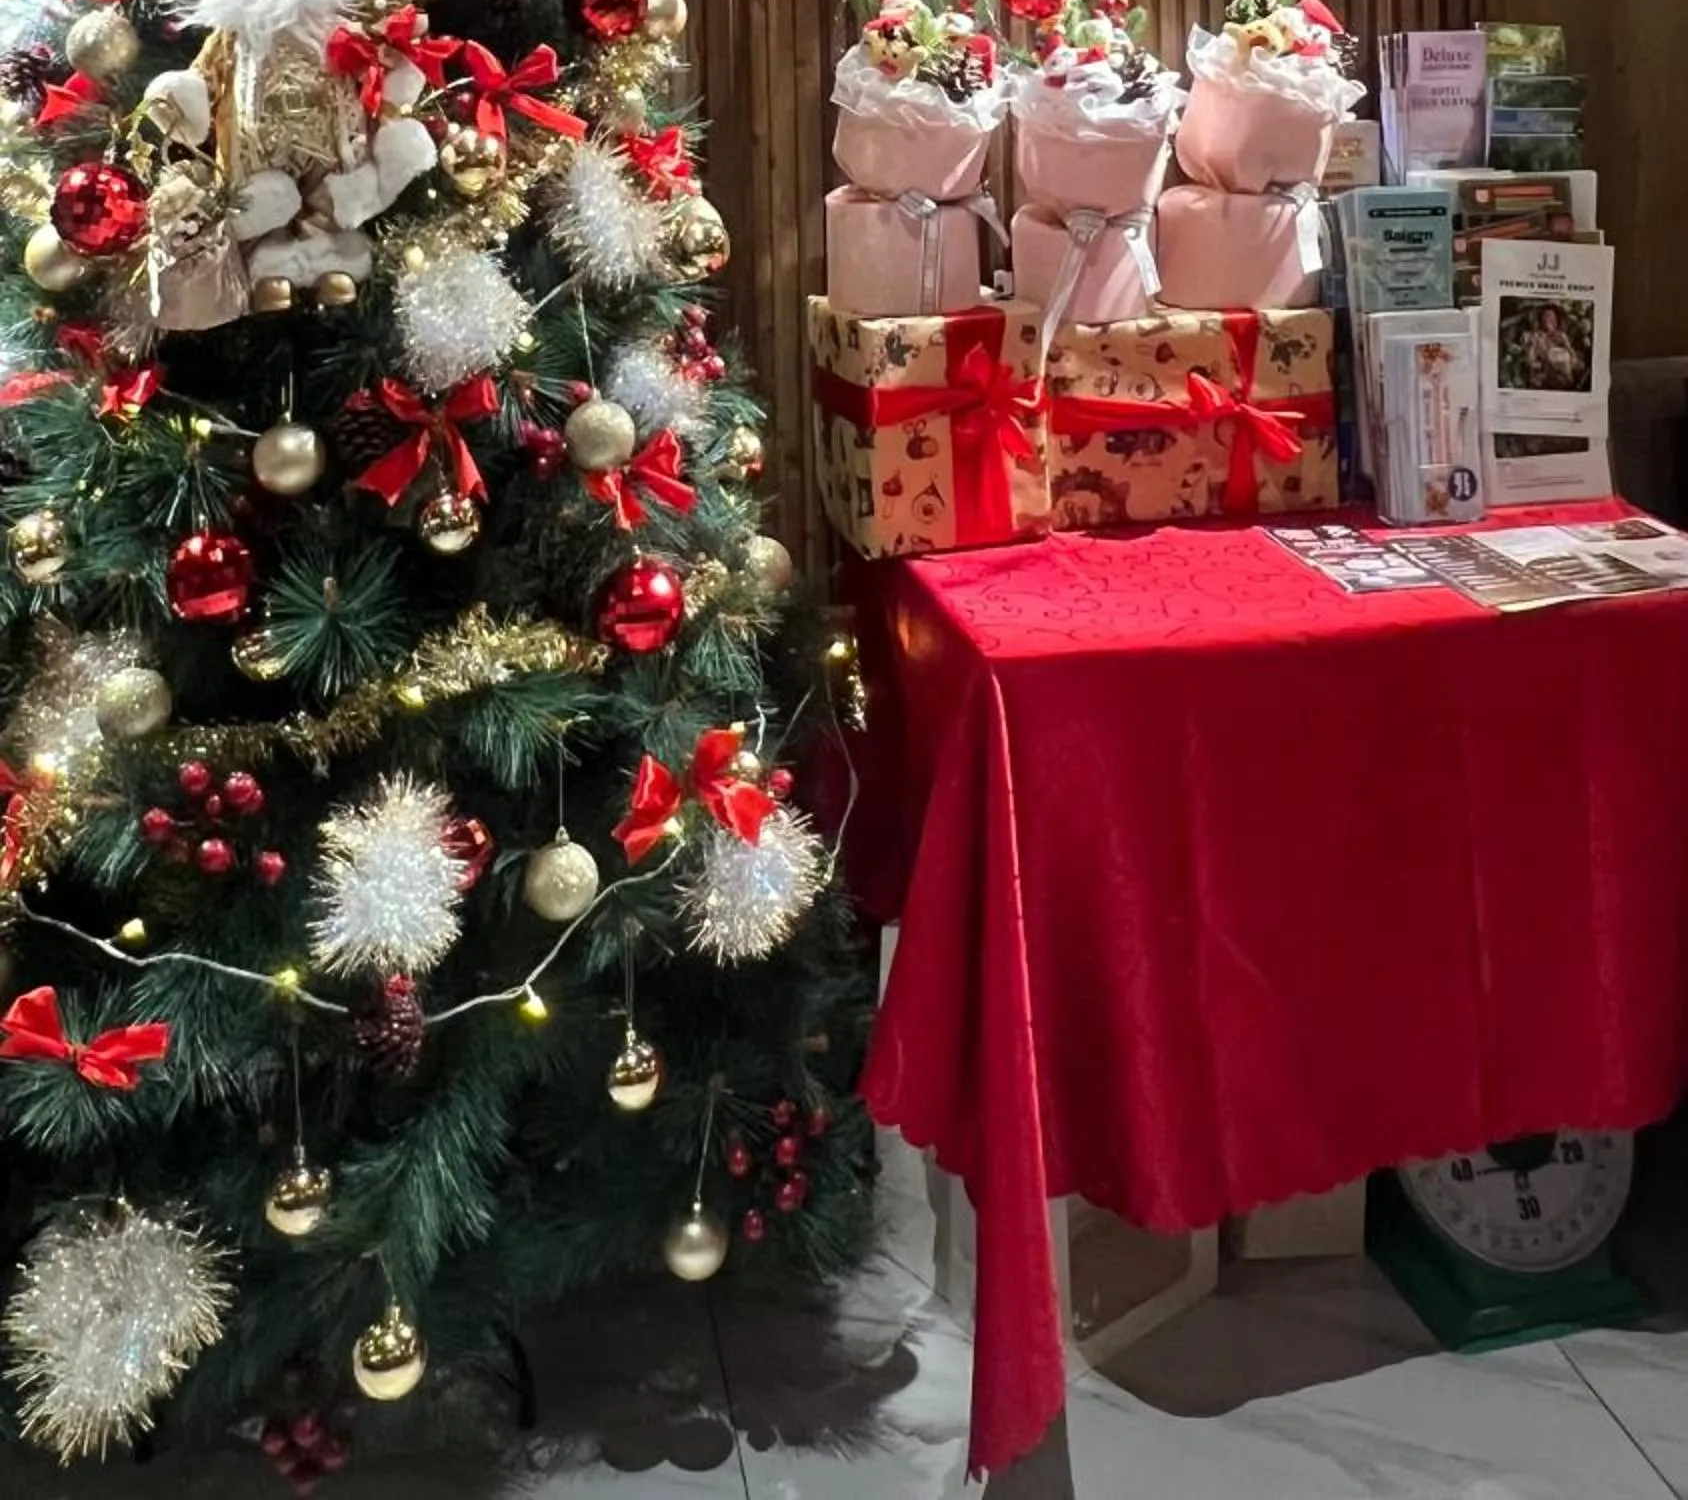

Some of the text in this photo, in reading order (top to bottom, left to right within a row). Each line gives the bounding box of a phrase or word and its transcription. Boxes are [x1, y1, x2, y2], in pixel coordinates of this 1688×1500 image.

[1422, 46, 1473, 61] Deluxe
[1383, 228, 1434, 245] Saigon
[1560, 1140, 1584, 1165] 20
[1451, 1158, 1475, 1183] 40
[1517, 1196, 1542, 1221] 30
